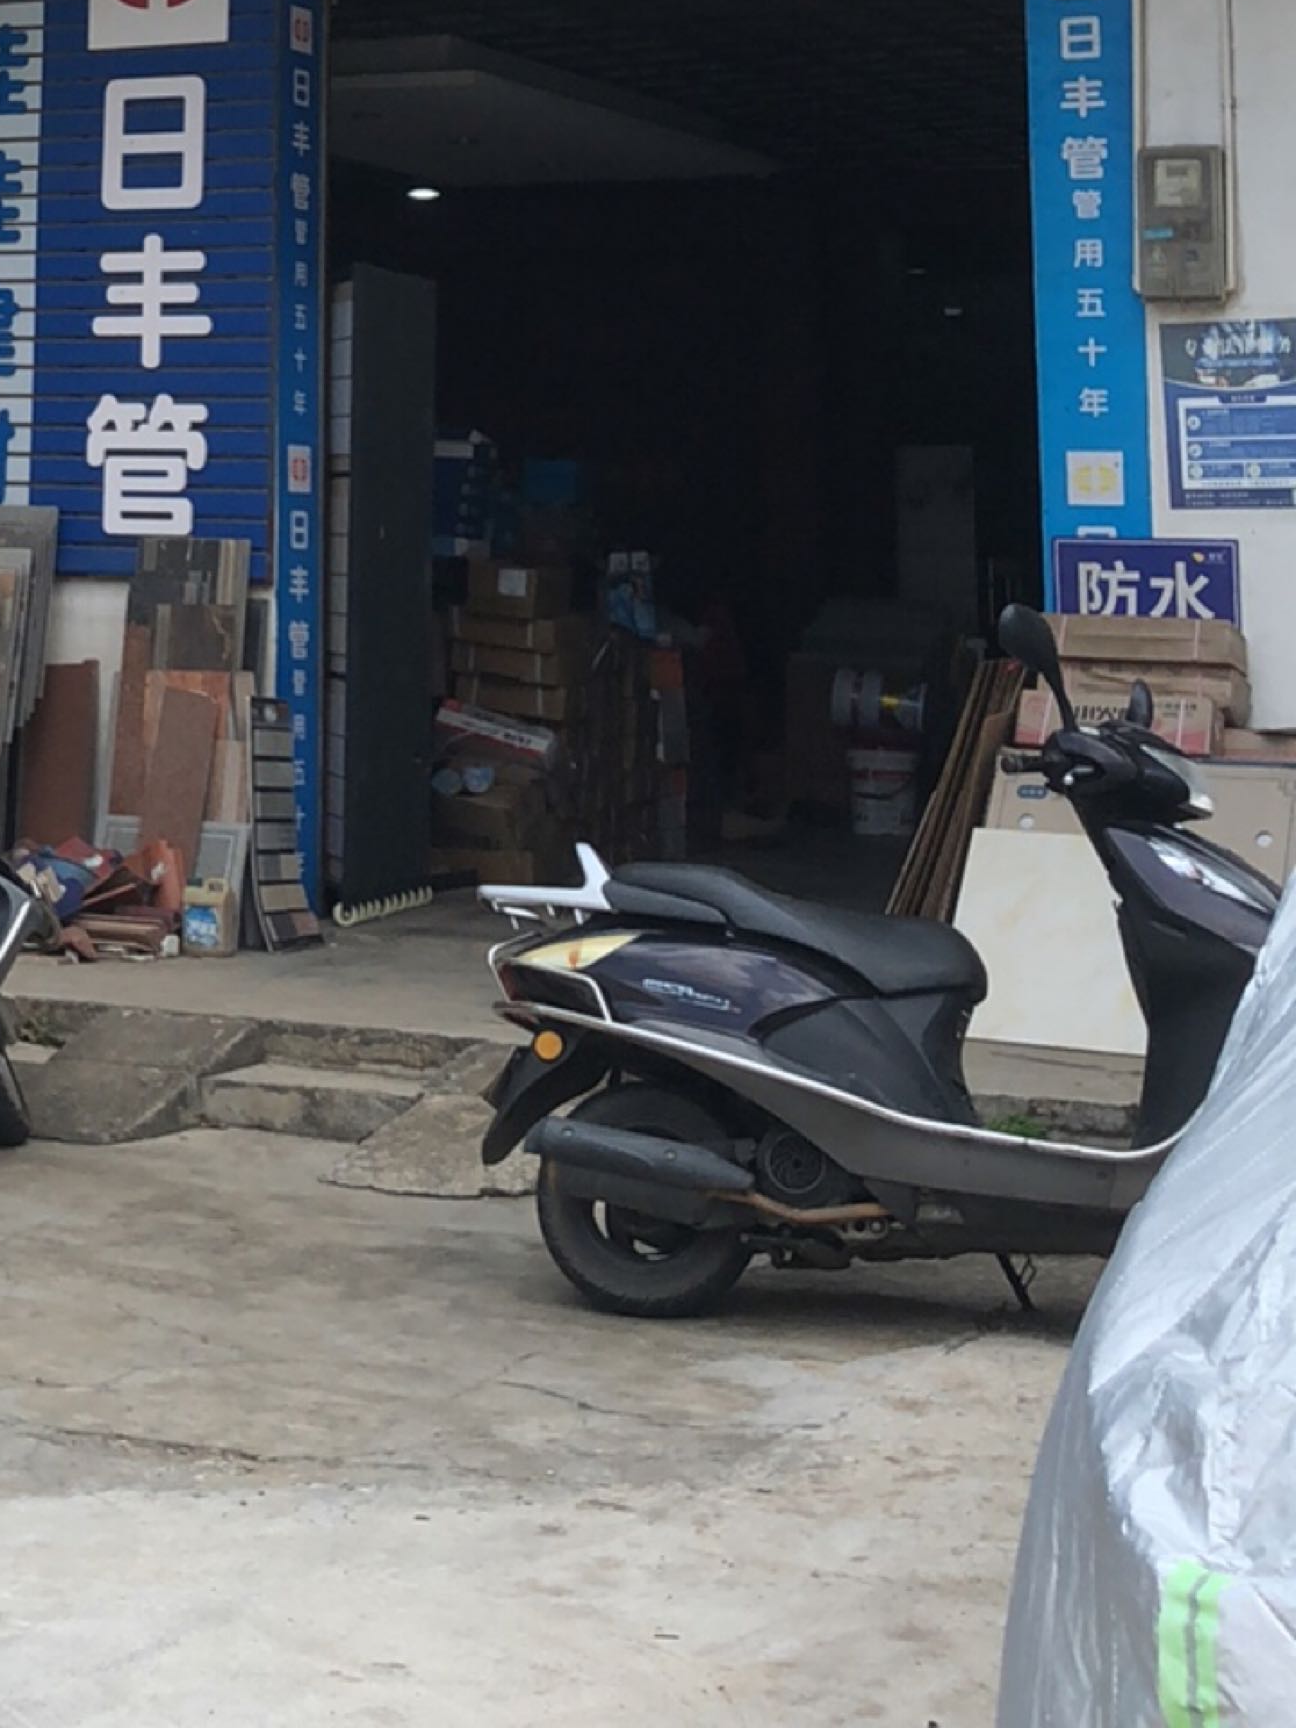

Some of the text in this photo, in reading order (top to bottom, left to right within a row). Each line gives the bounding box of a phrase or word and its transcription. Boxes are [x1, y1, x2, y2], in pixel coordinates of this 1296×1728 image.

[86, 75, 213, 536] 日丰管
[1077, 559, 1216, 620] 防水
